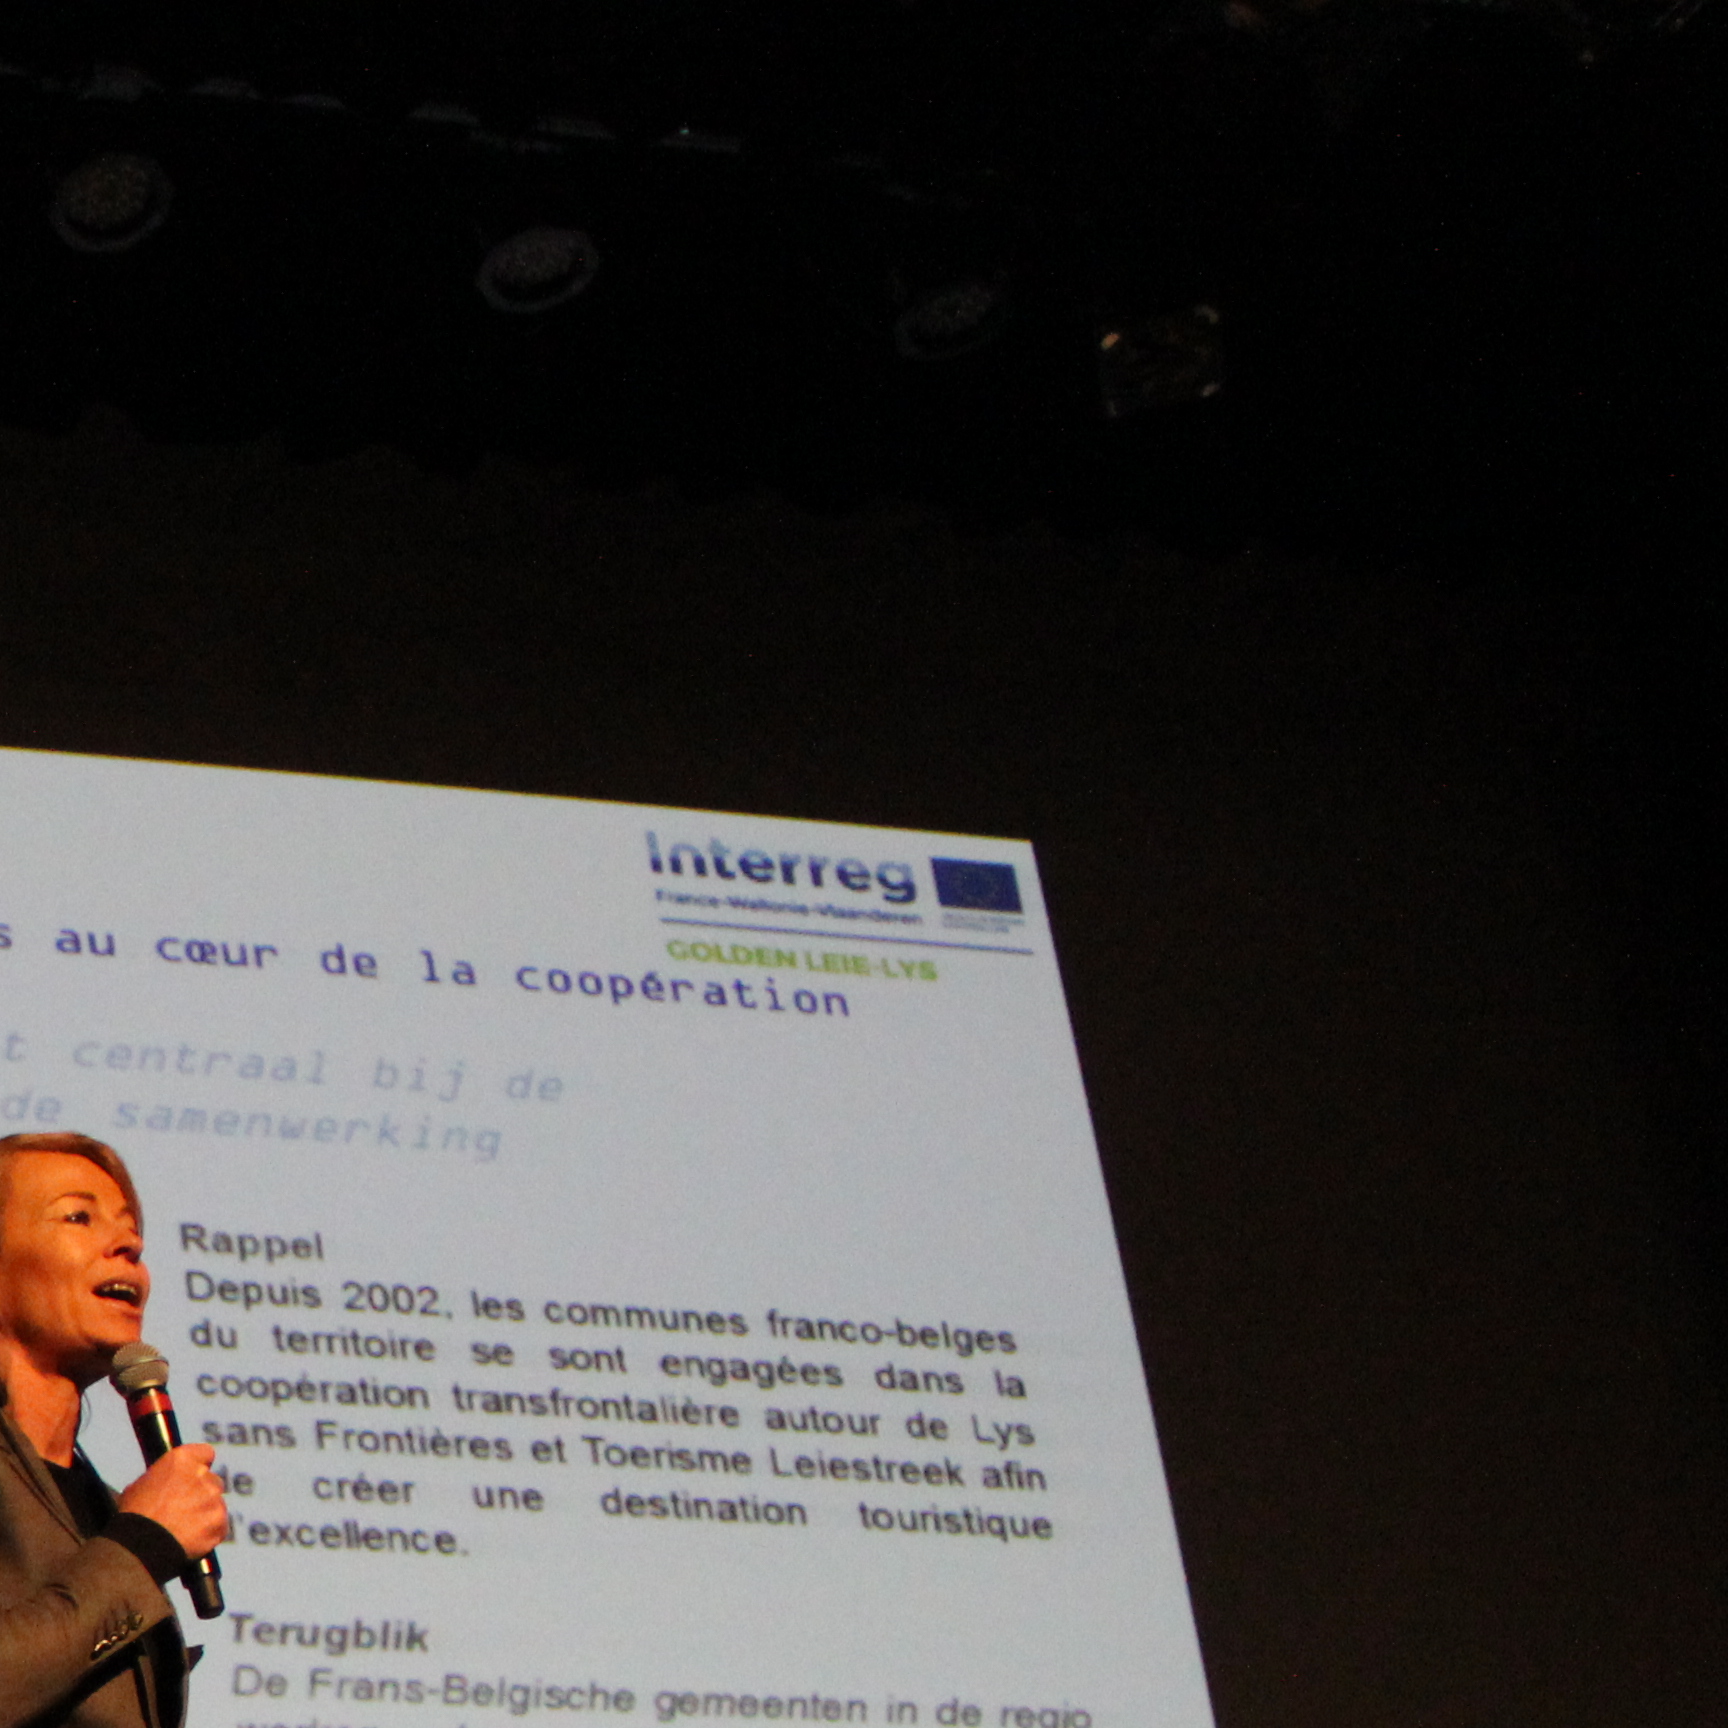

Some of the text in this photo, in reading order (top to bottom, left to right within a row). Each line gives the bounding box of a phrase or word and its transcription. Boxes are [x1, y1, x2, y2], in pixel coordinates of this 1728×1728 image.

[646, 831, 917, 905] Interreg
[55, 926, 117, 957] au
[156, 931, 278, 969] cœur
[321, 939, 378, 980] de
[421, 950, 476, 987] la
[515, 958, 849, 1018] coopération
[667, 939, 938, 981] GOLDEN LEIE-LYS
[73, 1036, 327, 1085] centraal
[372, 1056, 466, 1103] bij
[505, 1067, 564, 1103] de
[114, 1095, 503, 1163] samenwerking
[180, 1223, 324, 1263] Rappel
[185, 1270, 323, 1309] Depuis
[471, 1290, 525, 1321] les
[543, 1299, 748, 1337] communes
[767, 1309, 1017, 1357] franco-belges
[190, 1319, 1026, 1399] du territoire se sont engagées dans la
[197, 1372, 1035, 1451] coopération transfrontalière autour de Lys
[202, 1420, 1047, 1491] sans Frontières et Toerisme Leiestreek afin
[313, 1475, 414, 1504] créer
[474, 1485, 543, 1512] une
[601, 1487, 808, 1526] destination
[860, 1502, 1052, 1543] touristique
[228, 1613, 428, 1654] Terugblik
[232, 1664, 288, 1697] De
[308, 1667, 635, 1715] Frans-Belgische
[654, 1690, 867, 1723] gemeenten
[887, 1694, 917, 1725] in
[935, 1697, 982, 1727] de
